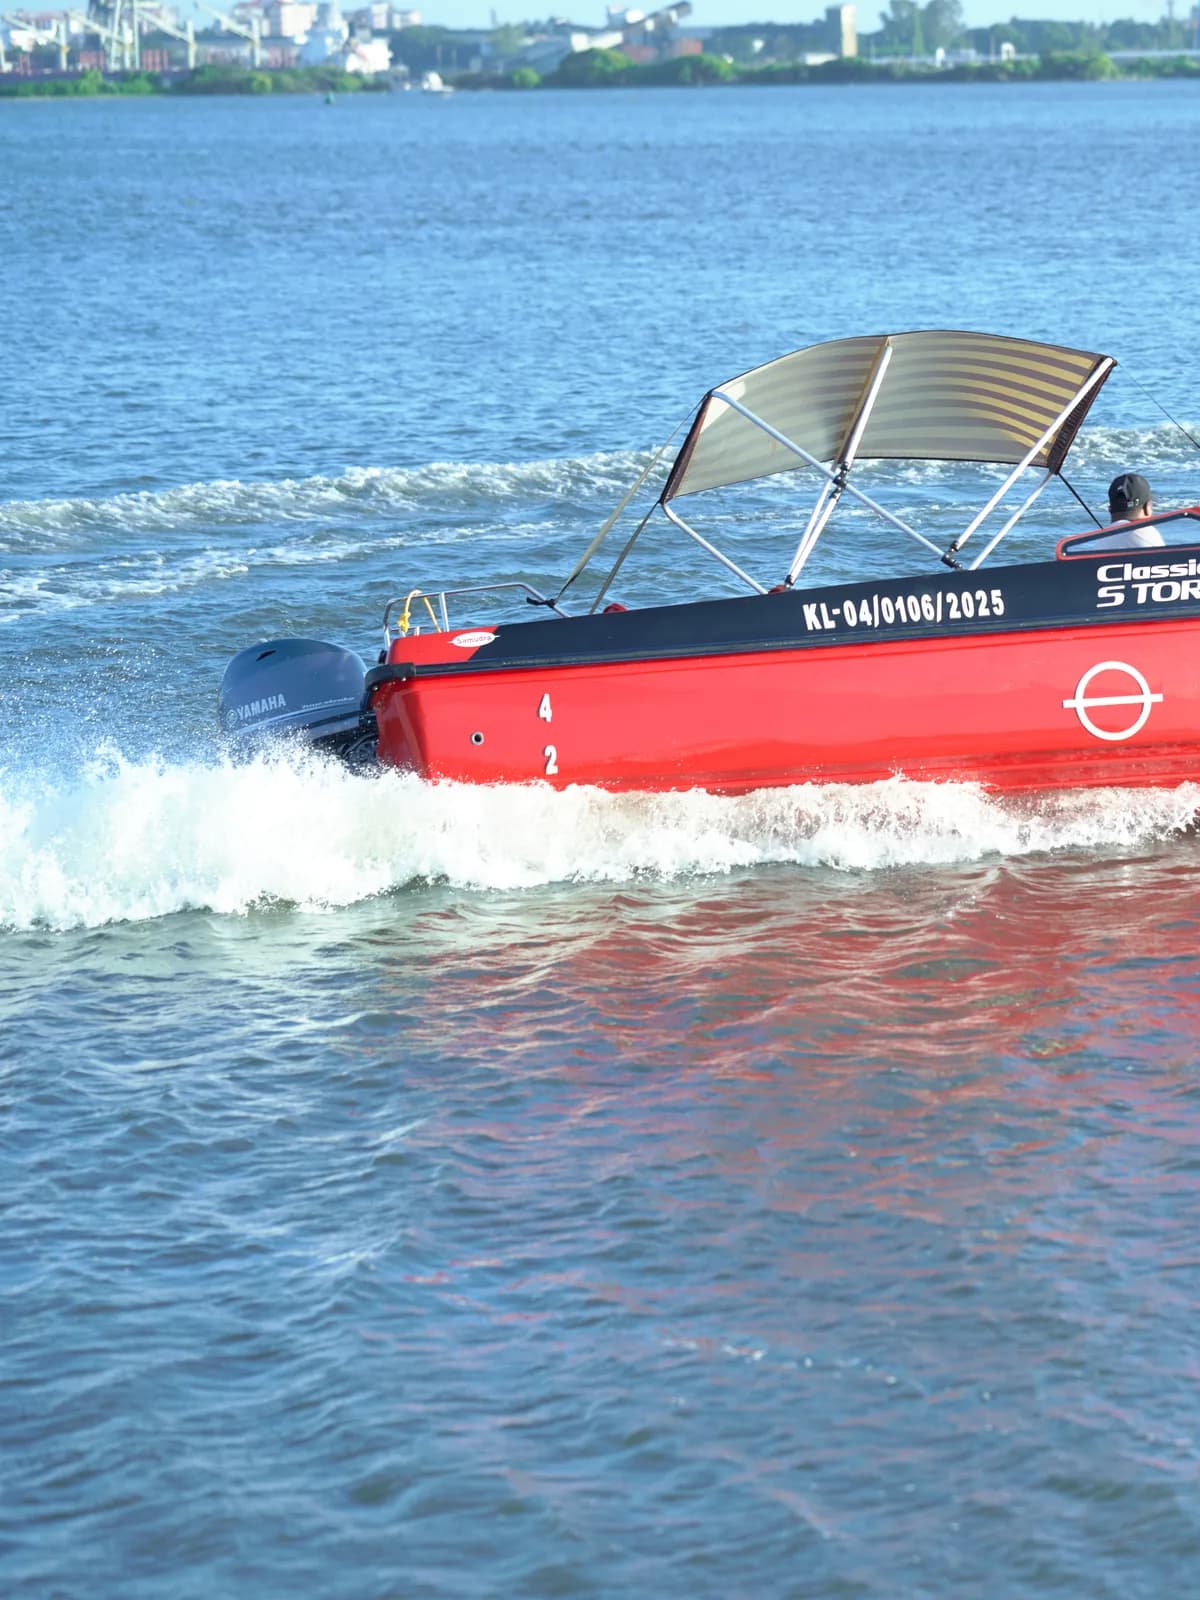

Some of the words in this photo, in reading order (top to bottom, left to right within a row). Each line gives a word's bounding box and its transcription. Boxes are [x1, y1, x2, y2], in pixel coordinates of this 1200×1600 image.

[803, 589, 1005, 631] KL-04/0106/2025
[456, 635, 492, 645] Samudra
[237, 694, 286, 720] YAMAHA
[539, 693, 552, 723] 4
[544, 744, 559, 775] 2
